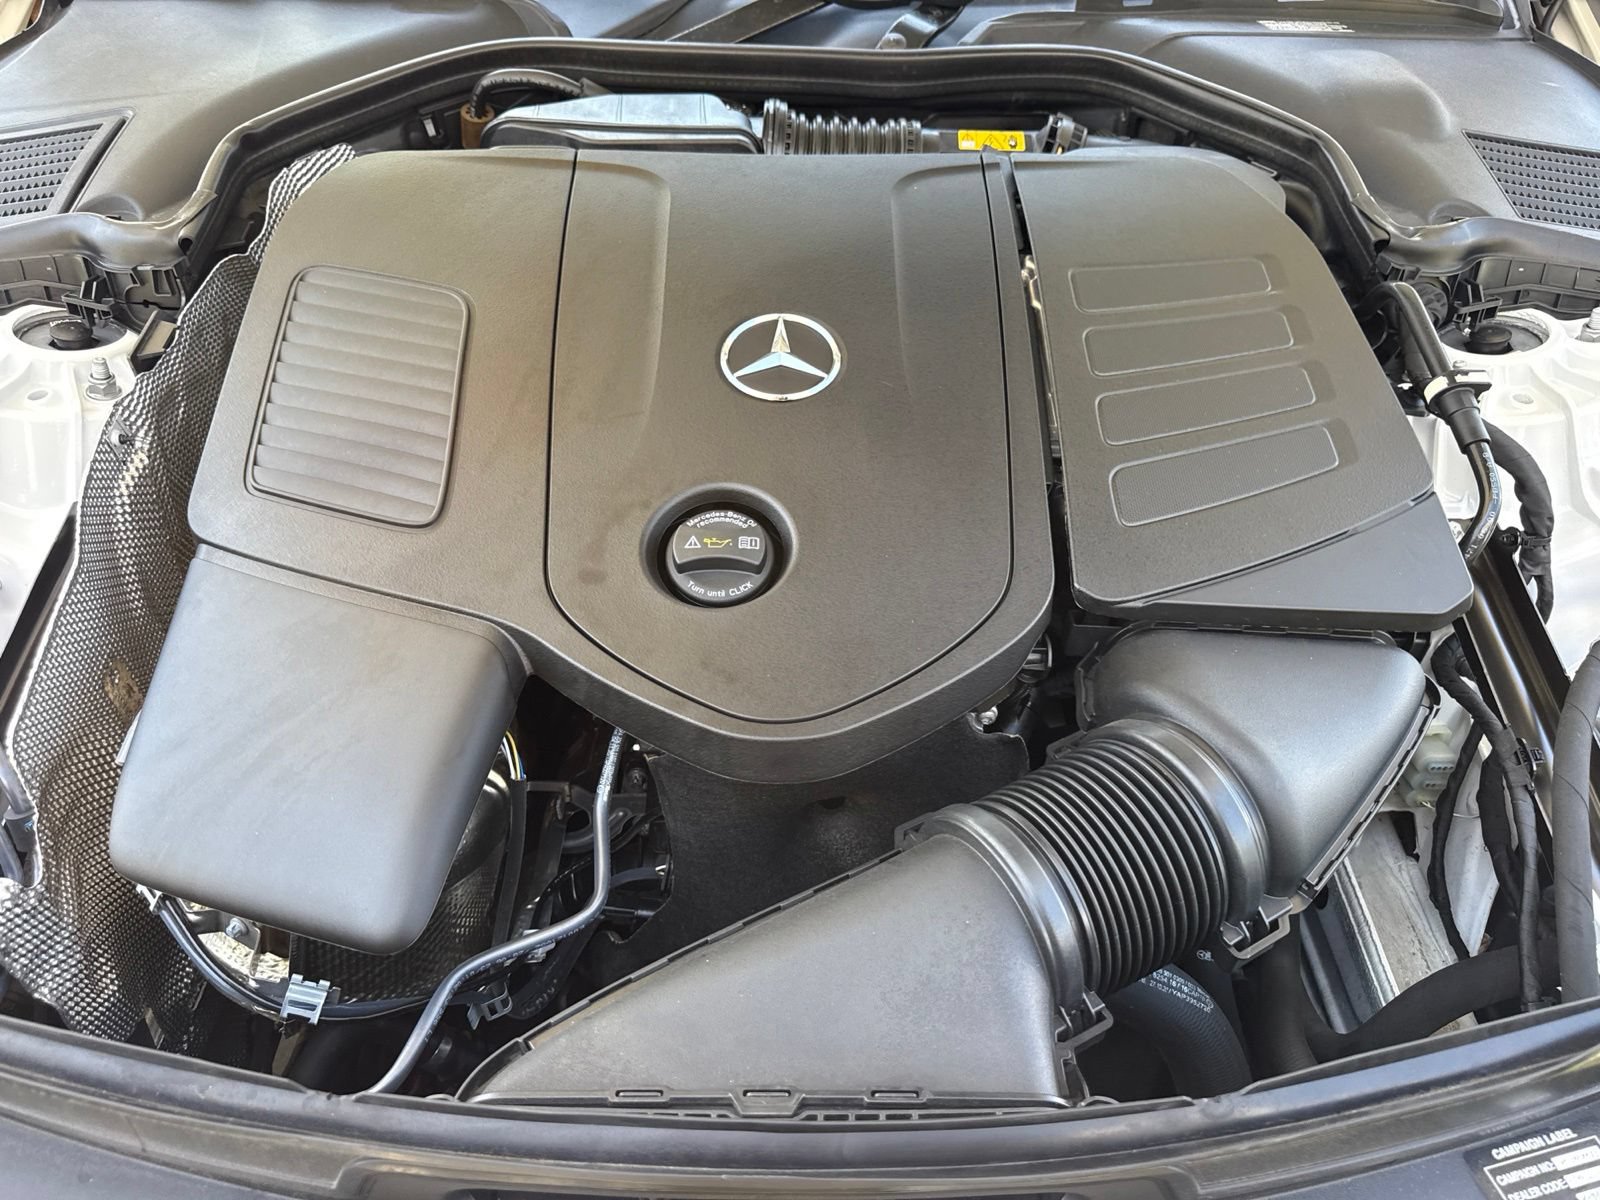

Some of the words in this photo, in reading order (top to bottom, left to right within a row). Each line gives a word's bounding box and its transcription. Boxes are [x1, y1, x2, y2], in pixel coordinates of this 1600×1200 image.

[686, 511, 746, 527] Mercedes-Benz
[696, 517, 749, 529] recommended
[687, 580, 705, 595] Turn
[707, 589, 726, 597] until
[729, 581, 754, 596] CLICK
[1491, 1136, 1546, 1160] CAMPAIGN
[1542, 1128, 1578, 1145] LABEL
[1495, 1165, 1540, 1186] CAMPAIGN
